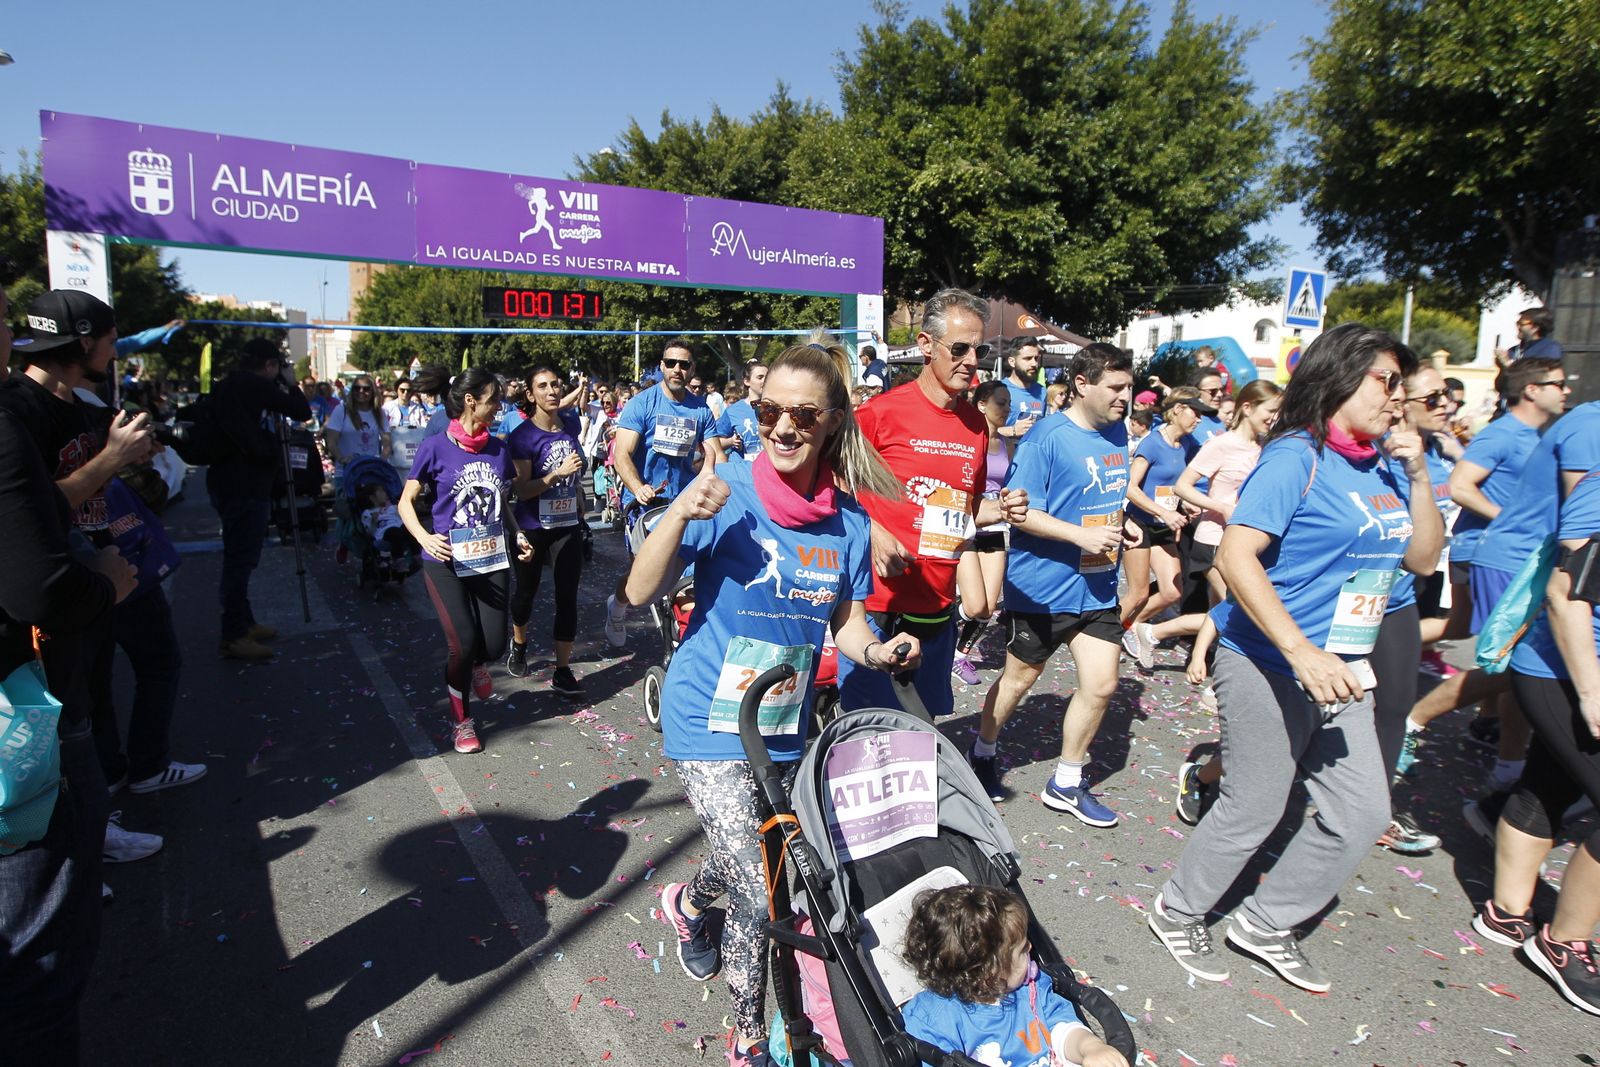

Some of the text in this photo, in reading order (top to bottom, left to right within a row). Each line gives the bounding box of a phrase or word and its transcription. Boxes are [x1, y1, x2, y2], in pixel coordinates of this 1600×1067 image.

[211, 164, 377, 209] ALMERÍA
[559, 190, 599, 211] VIII
[211, 197, 300, 223] CIUDAD
[559, 211, 601, 222] CARRERA
[559, 225, 602, 244] mujer
[426, 244, 681, 276] LA IGUALDAD ES NUESTRA META.
[663, 427, 690, 440] 1255
[909, 439, 976, 454] CARRERA POPULAR
[914, 446, 974, 461] POR LA CONVIVENCIA
[462, 461, 492, 473] JUNTAS
[1102, 453, 1125, 467] VIII
[548, 499, 573, 510] 1257
[1366, 493, 1403, 511] VIII
[462, 538, 497, 555] 1256
[796, 544, 840, 571] VIII
[795, 569, 840, 583] CARRERA
[1350, 594, 1389, 616] 213
[831, 769, 931, 813] ATLETA
